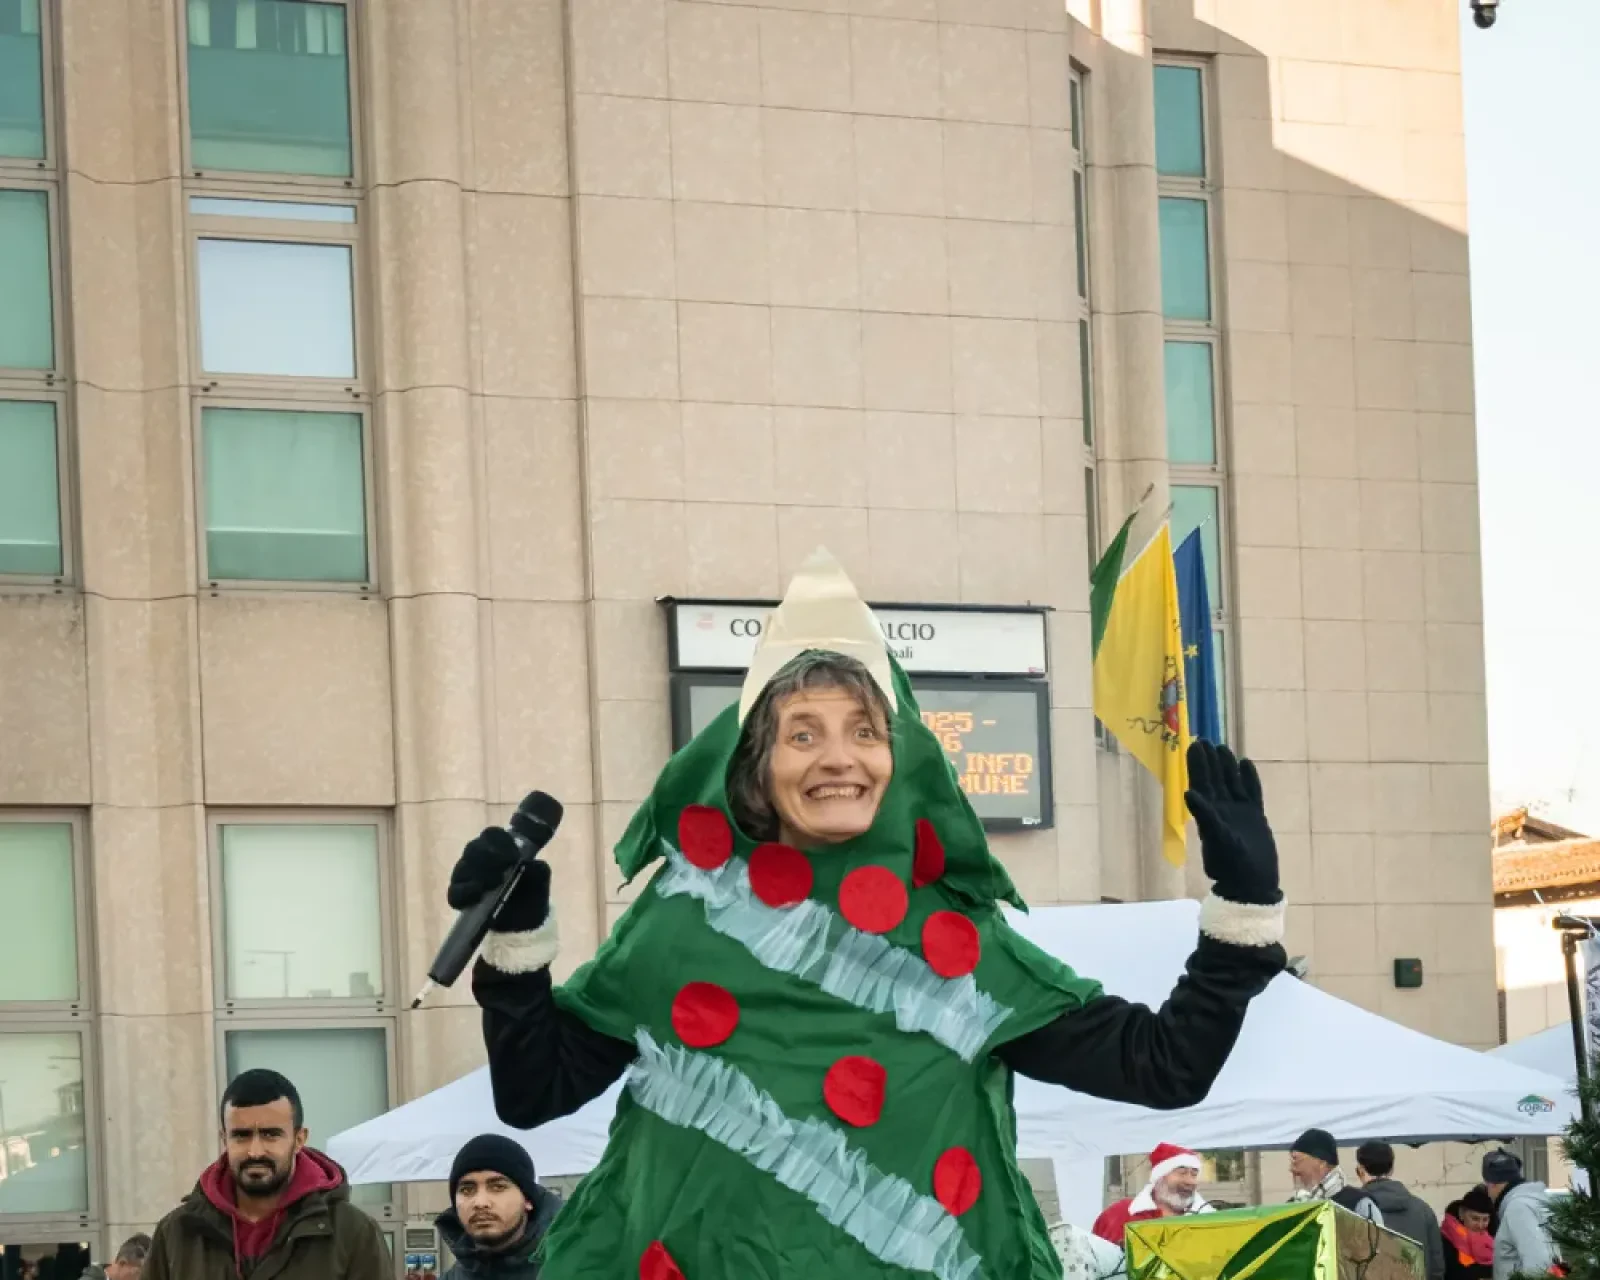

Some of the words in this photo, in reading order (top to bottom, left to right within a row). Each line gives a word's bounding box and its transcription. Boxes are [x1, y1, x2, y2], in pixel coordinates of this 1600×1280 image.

[730, 618, 762, 637] CO
[881, 622, 935, 641] LCIO
[919, 711, 974, 732] 025
[965, 752, 1033, 774] INFO
[958, 773, 1029, 794] MUNE
